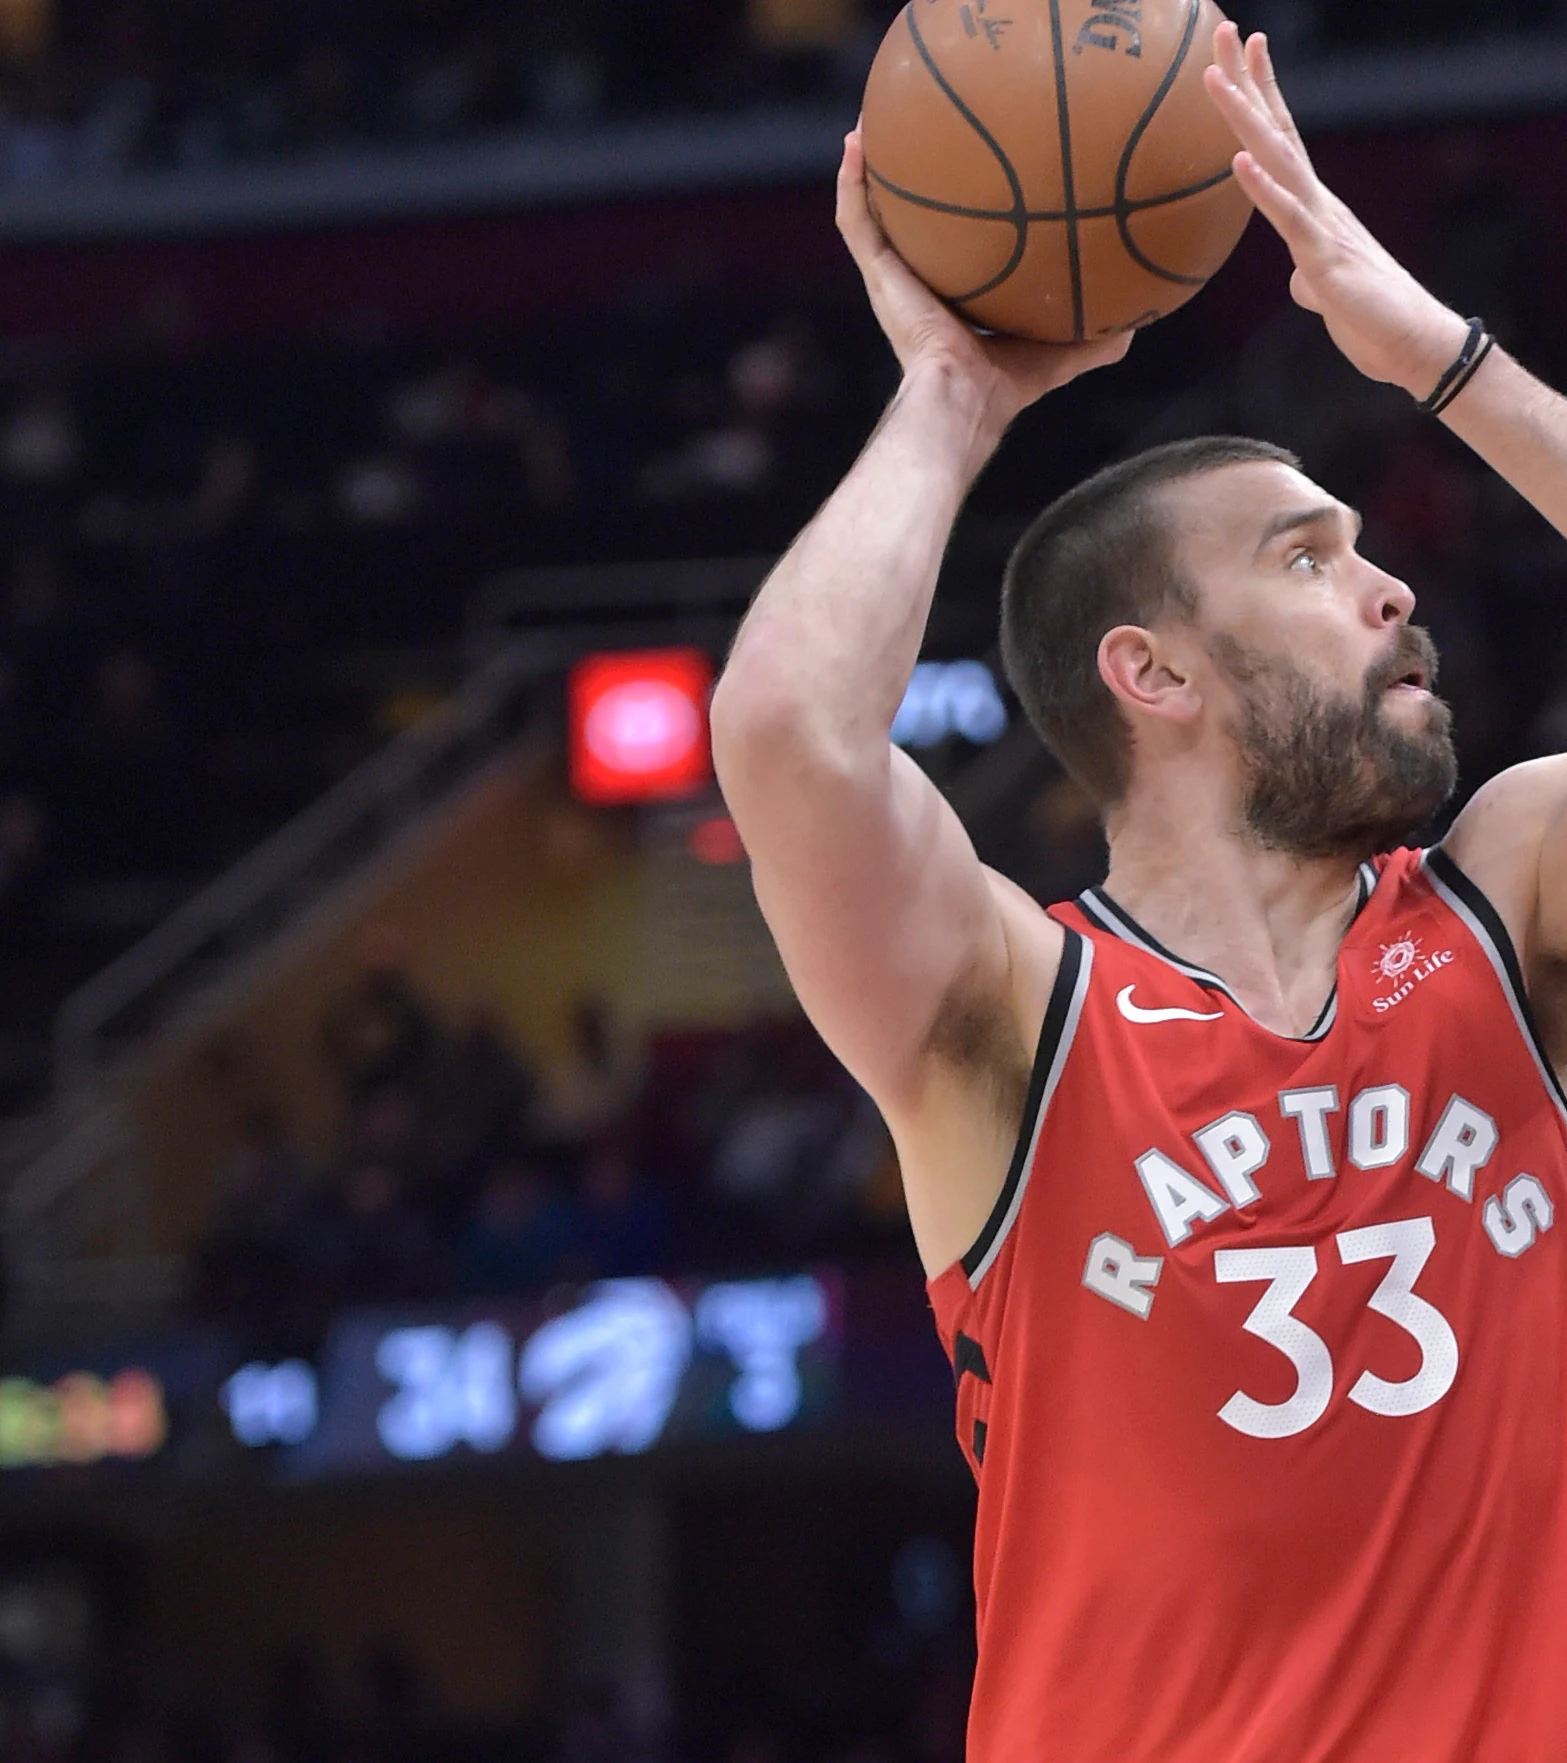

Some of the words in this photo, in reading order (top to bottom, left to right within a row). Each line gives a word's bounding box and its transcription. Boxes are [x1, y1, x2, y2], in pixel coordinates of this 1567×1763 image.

[1372, 981, 1414, 1013] Sun
[1413, 950, 1455, 982] Life
[1082, 1082, 1553, 1321] RAPTORS
[1214, 1216, 1459, 1440] 33
